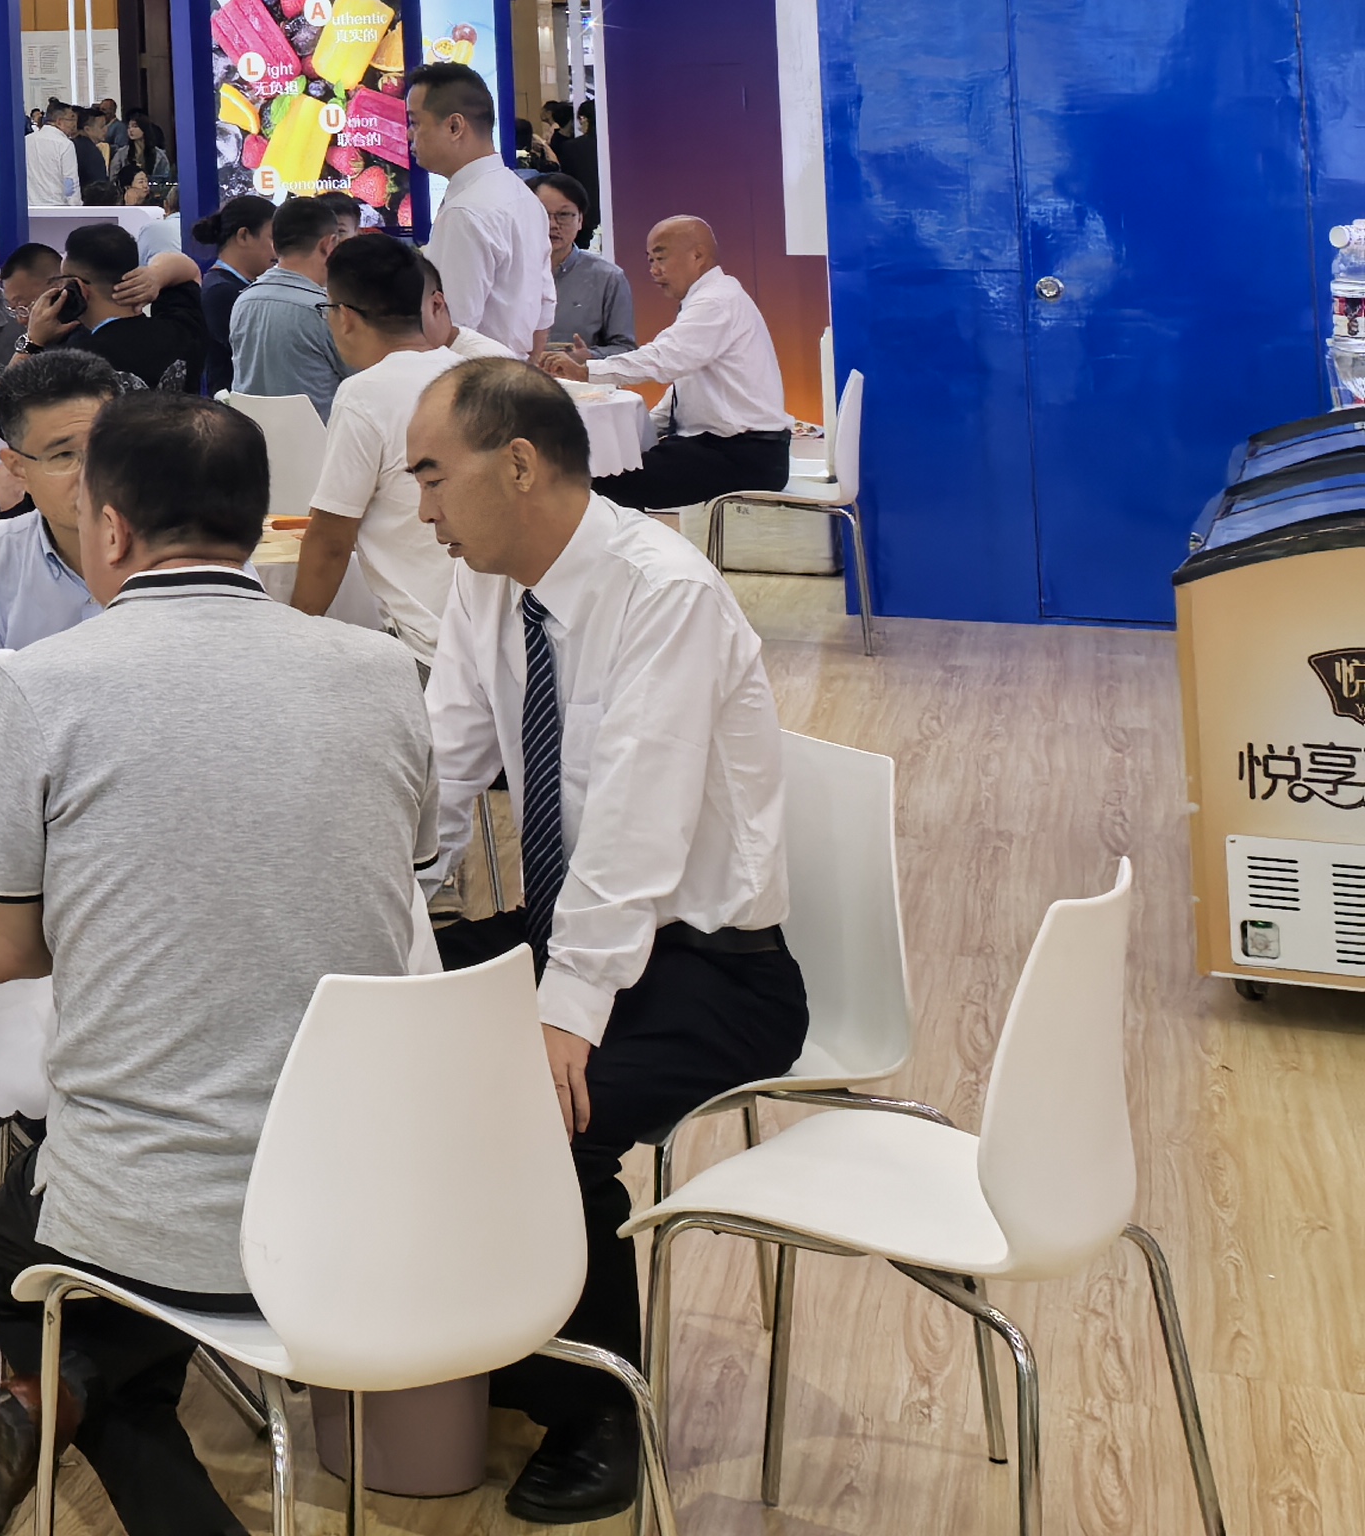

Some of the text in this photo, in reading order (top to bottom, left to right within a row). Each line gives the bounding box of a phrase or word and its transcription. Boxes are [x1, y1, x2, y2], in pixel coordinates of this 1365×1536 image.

[335, 28, 378, 43] 真实的
[254, 80, 299, 96] 无负担
[337, 132, 381, 147] 联合的
